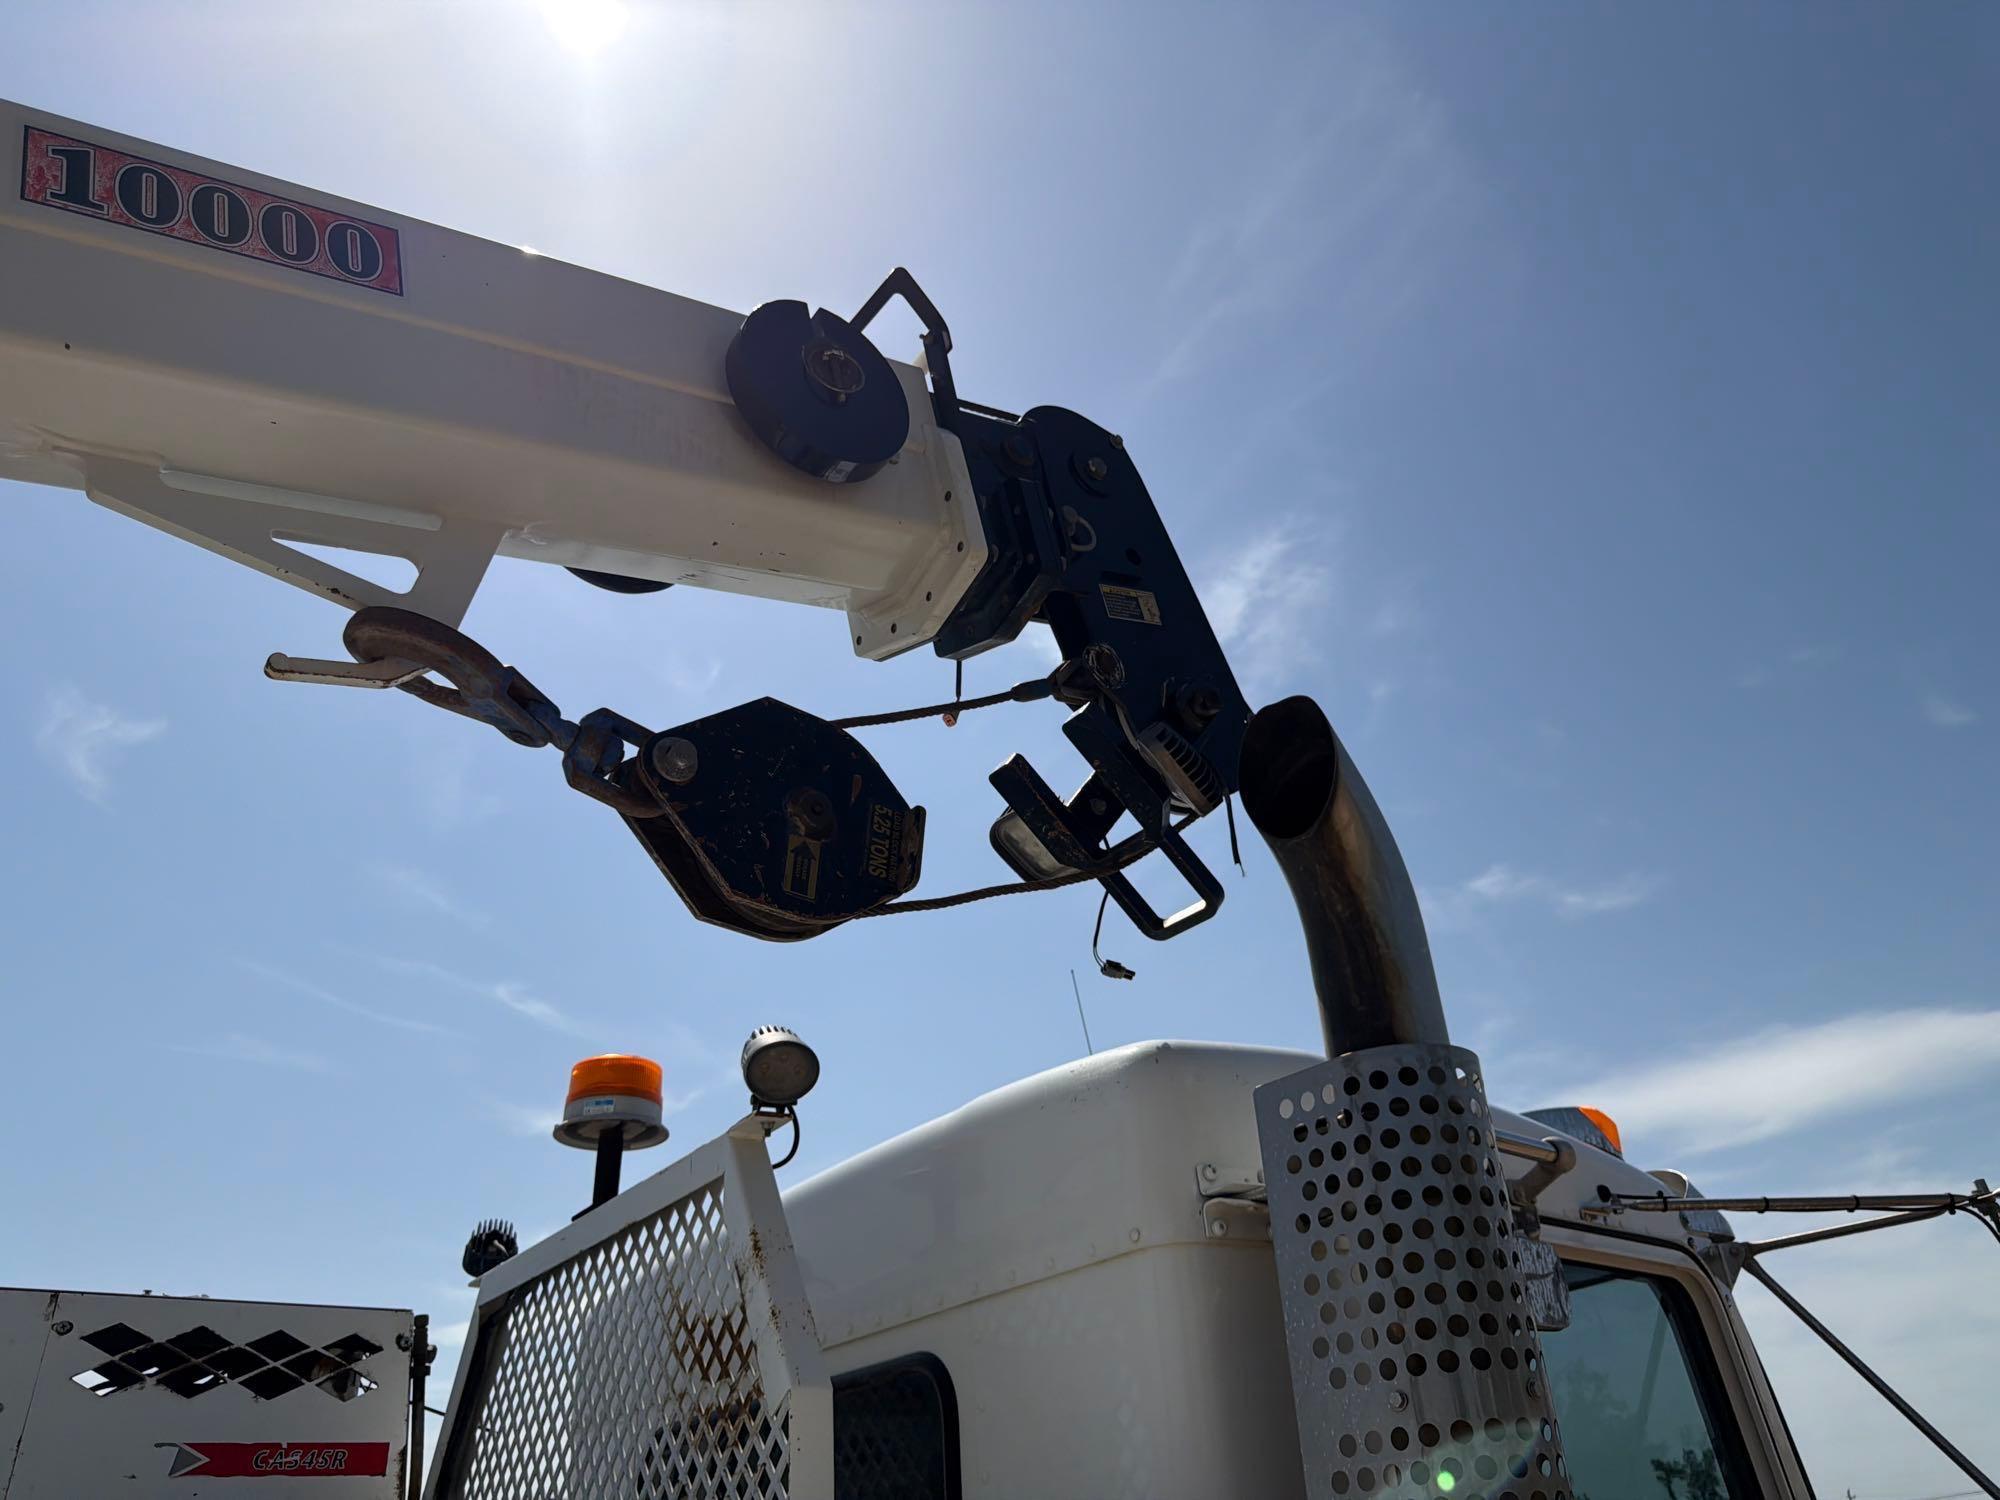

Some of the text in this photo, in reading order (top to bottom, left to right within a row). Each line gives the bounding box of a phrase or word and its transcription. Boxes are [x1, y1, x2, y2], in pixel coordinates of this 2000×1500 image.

[46, 146, 382, 280] 10000
[869, 805, 892, 878] 5.25 TONS
